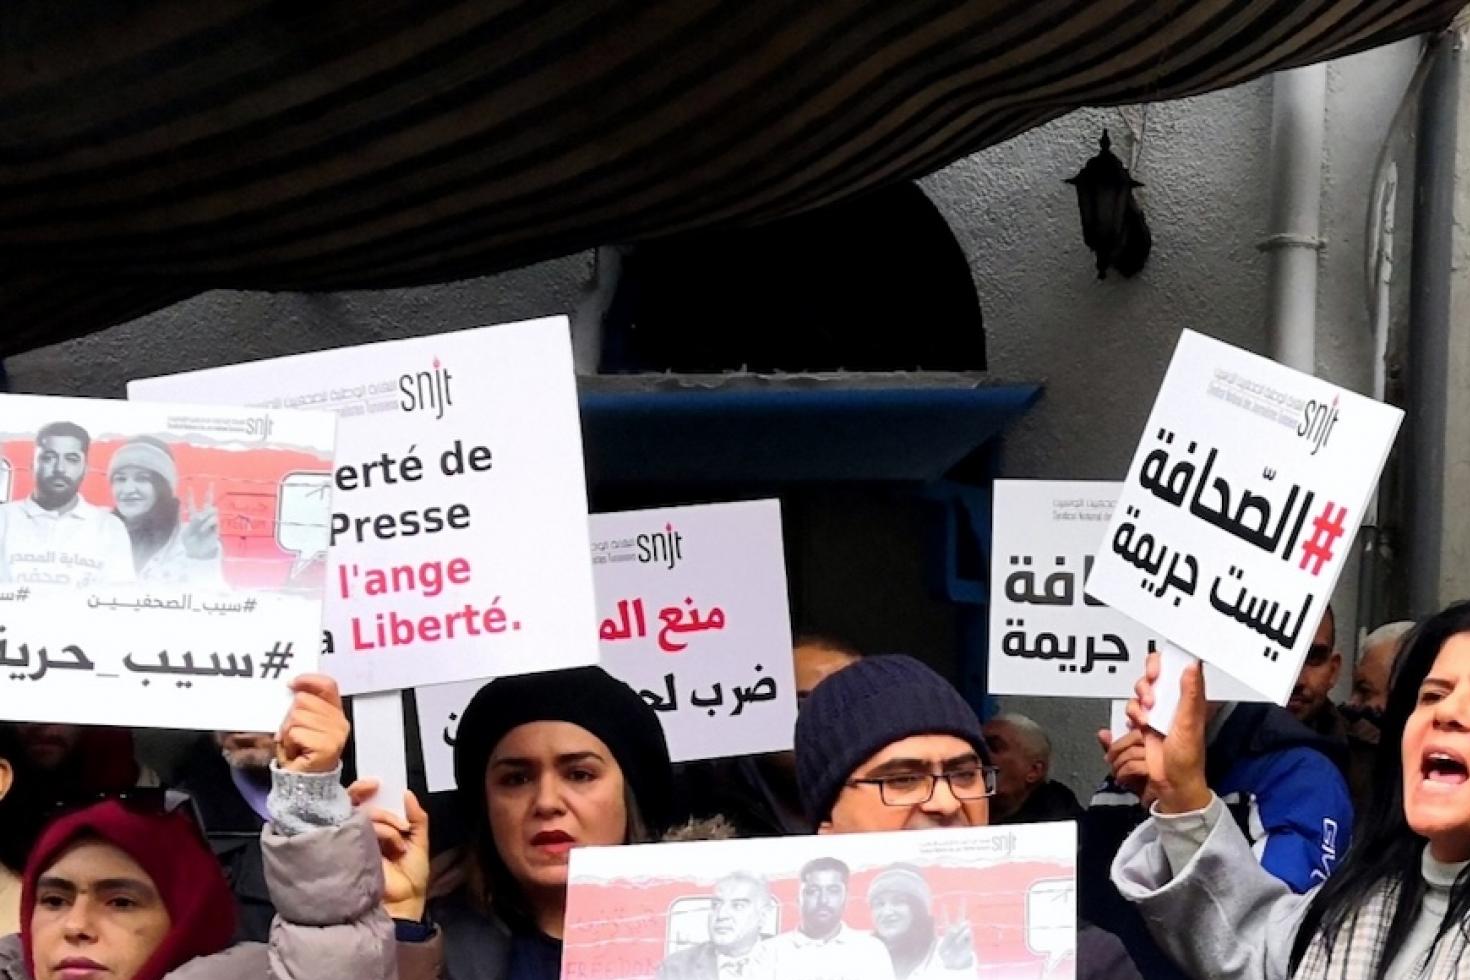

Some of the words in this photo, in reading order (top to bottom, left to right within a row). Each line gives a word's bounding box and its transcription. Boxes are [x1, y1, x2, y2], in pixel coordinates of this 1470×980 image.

[399, 355, 453, 420] snjt
[335, 444, 424, 491] erté
[440, 440, 493, 476] de
[330, 503, 471, 546] Presse
[636, 523, 683, 570] snjt
[338, 557, 471, 599] l'ange
[1112, 505, 1198, 607] جريمة
[321, 629, 335, 654] a
[351, 595, 521, 651] Liberté.
[658, 597, 725, 652] منع
[1210, 565, 1314, 663] ليست
[1002, 618, 1130, 674] جريمة
[690, 664, 777, 716] ضرب
